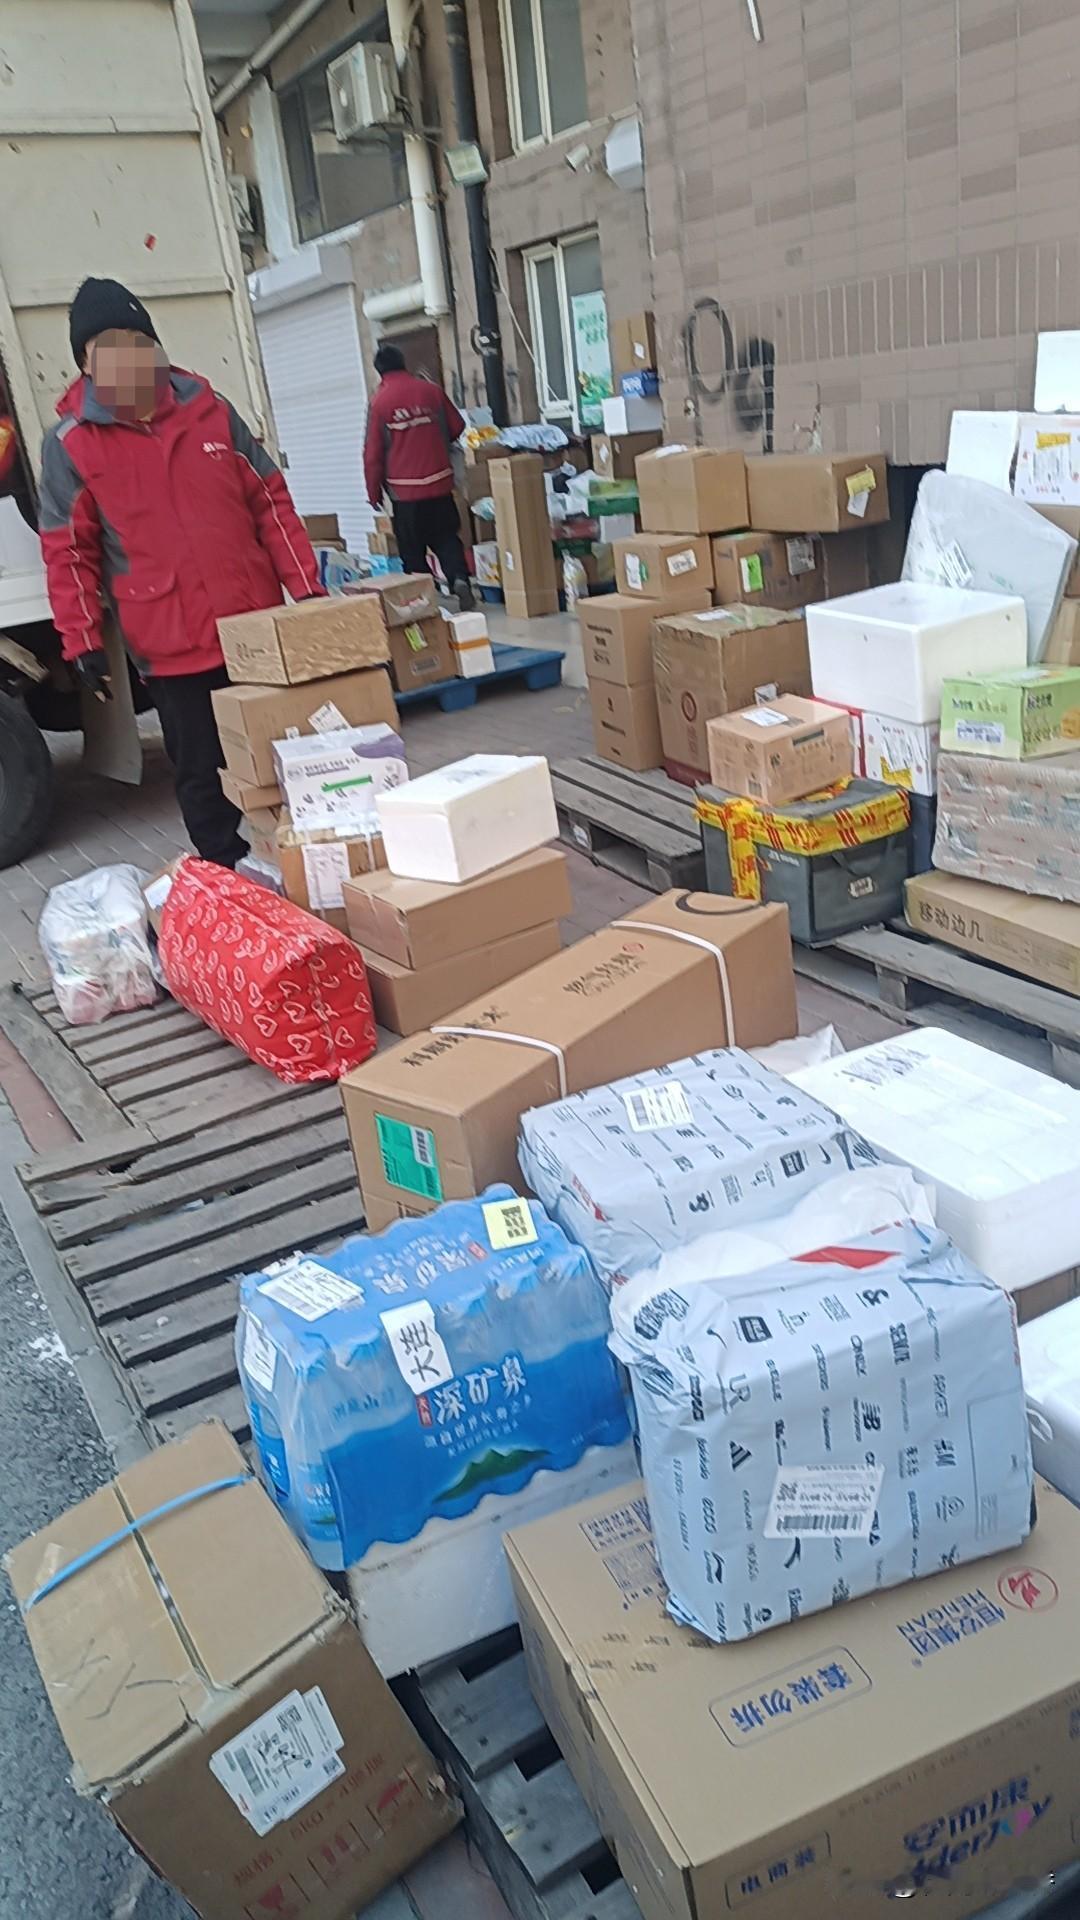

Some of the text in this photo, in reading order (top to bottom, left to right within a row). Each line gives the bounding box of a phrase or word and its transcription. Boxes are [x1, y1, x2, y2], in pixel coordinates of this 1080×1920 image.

[918, 900, 984, 943] 移动边几
[433, 1355, 528, 1426] 深矿泉
[896, 1588, 987, 1640] HENGAN
[908, 1604, 1007, 1657] 恒安集团
[730, 1661, 854, 1733] 套装勿拆
[903, 1775, 1031, 1853] 安而康
